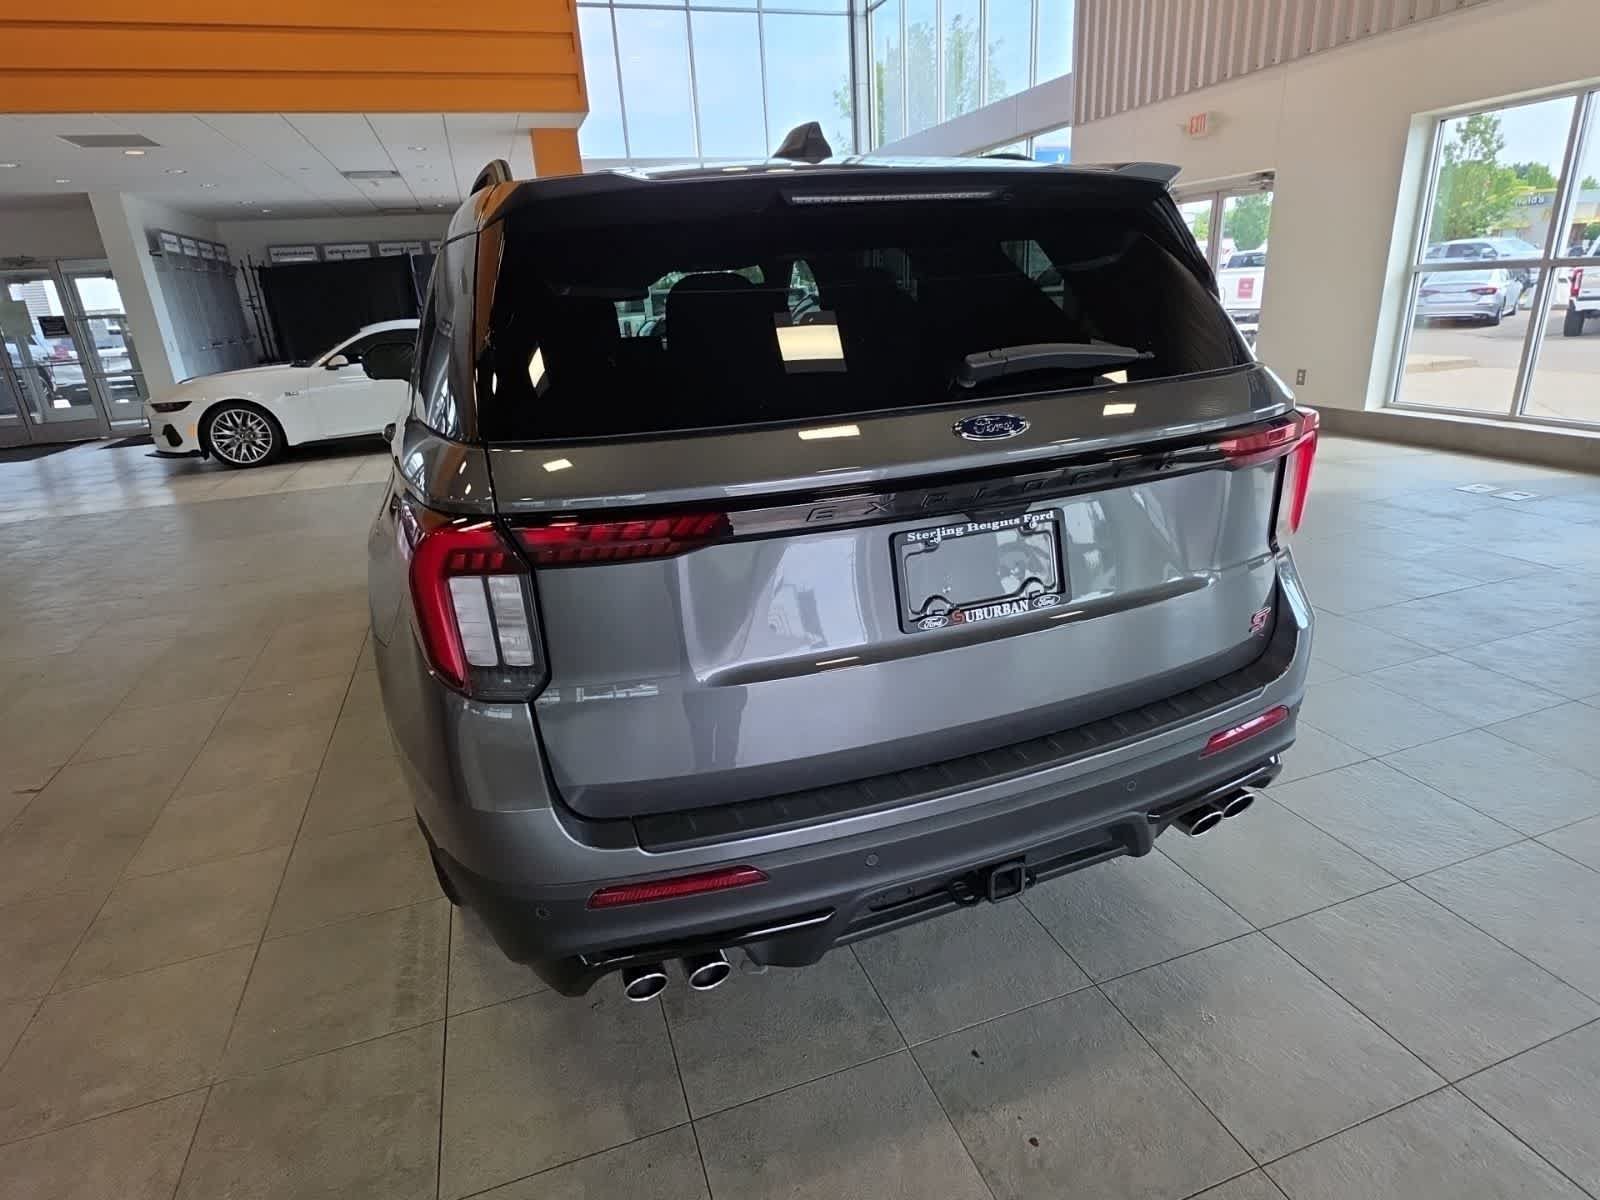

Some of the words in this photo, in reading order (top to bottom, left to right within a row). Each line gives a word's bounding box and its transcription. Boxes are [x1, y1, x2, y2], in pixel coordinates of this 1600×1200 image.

[971, 417, 1016, 434] Ford
[906, 527, 964, 542] Sterling
[967, 516, 1020, 531] Heights
[1023, 510, 1054, 524] Ford
[951, 600, 1029, 625] SUBURBAN
